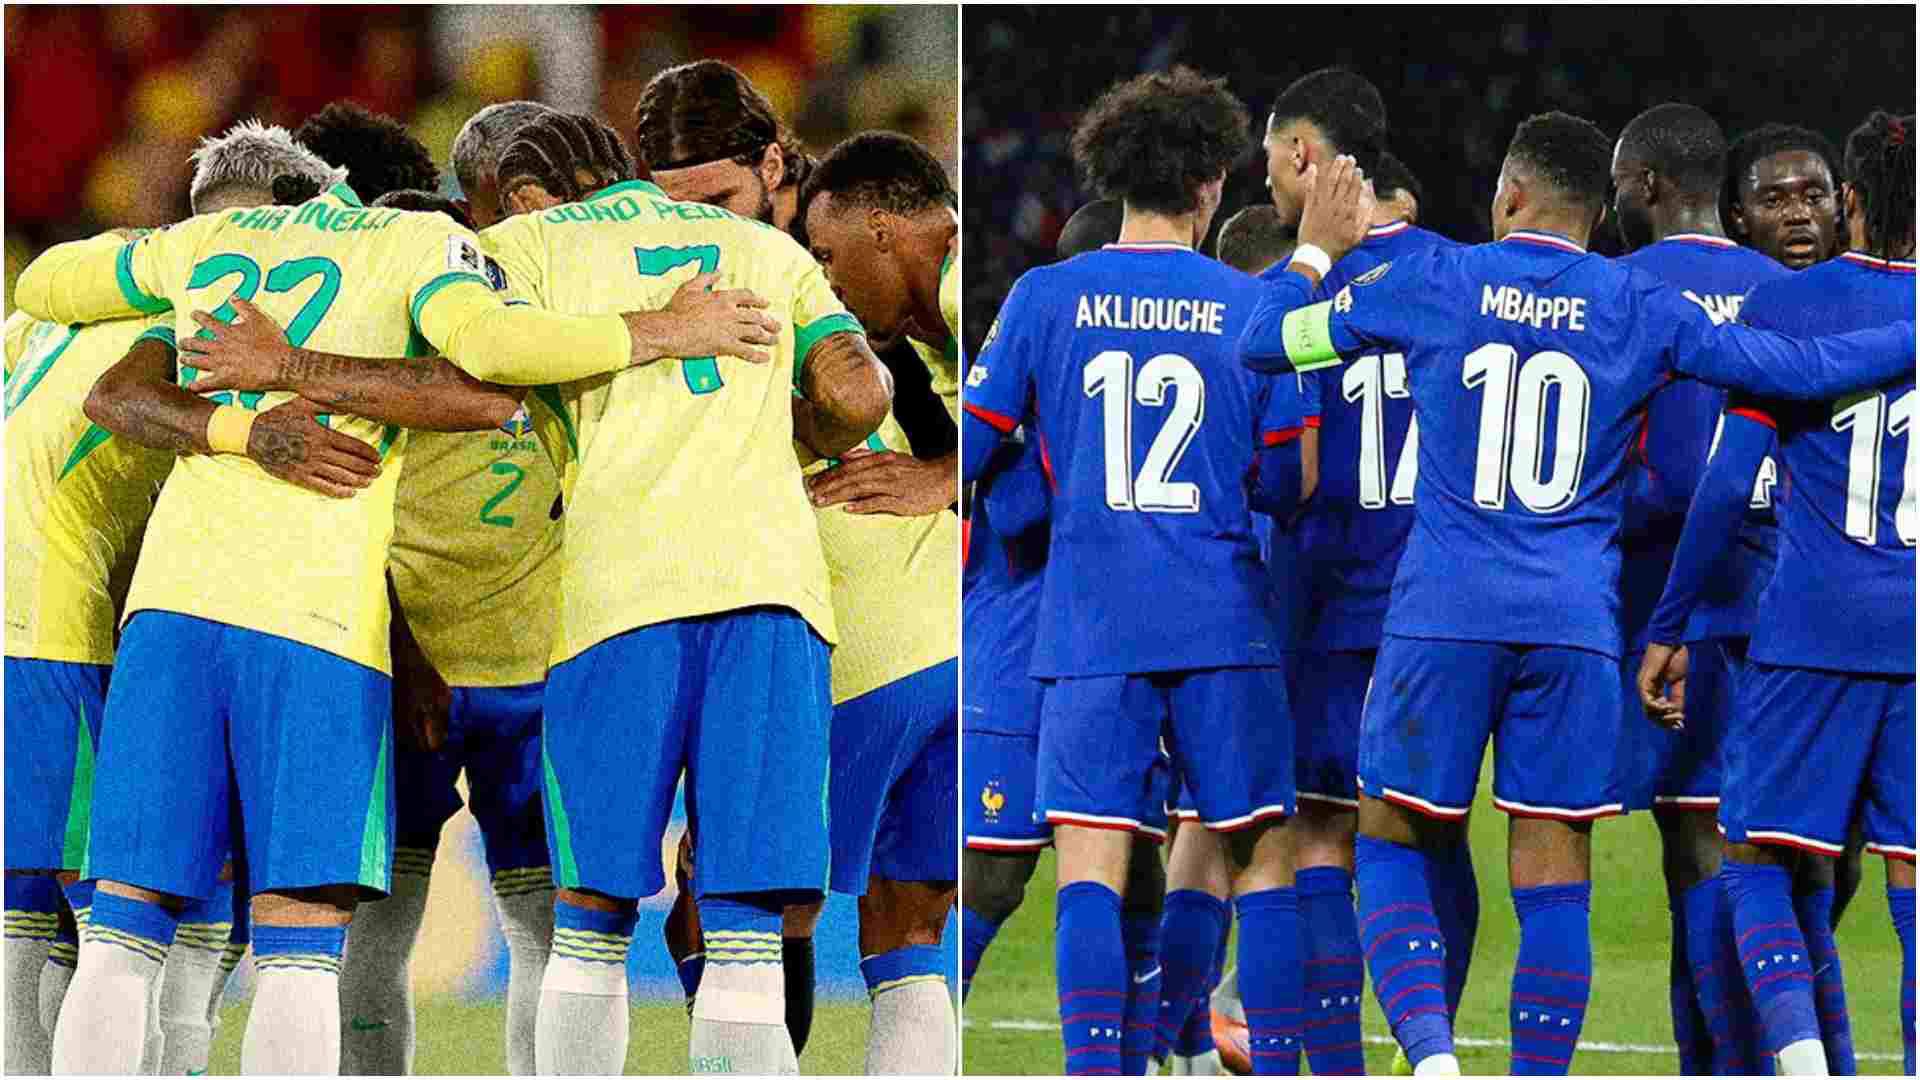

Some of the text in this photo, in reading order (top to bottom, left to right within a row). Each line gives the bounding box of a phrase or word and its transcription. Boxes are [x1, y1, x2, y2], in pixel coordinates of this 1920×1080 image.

[634, 243, 724, 395] 7
[1075, 295, 1226, 335] AKLIOUCHE
[1480, 284, 1587, 331] MBAPPE
[1083, 351, 1205, 513] 12
[1462, 342, 1591, 514] 10
[480, 463, 525, 528] 2
